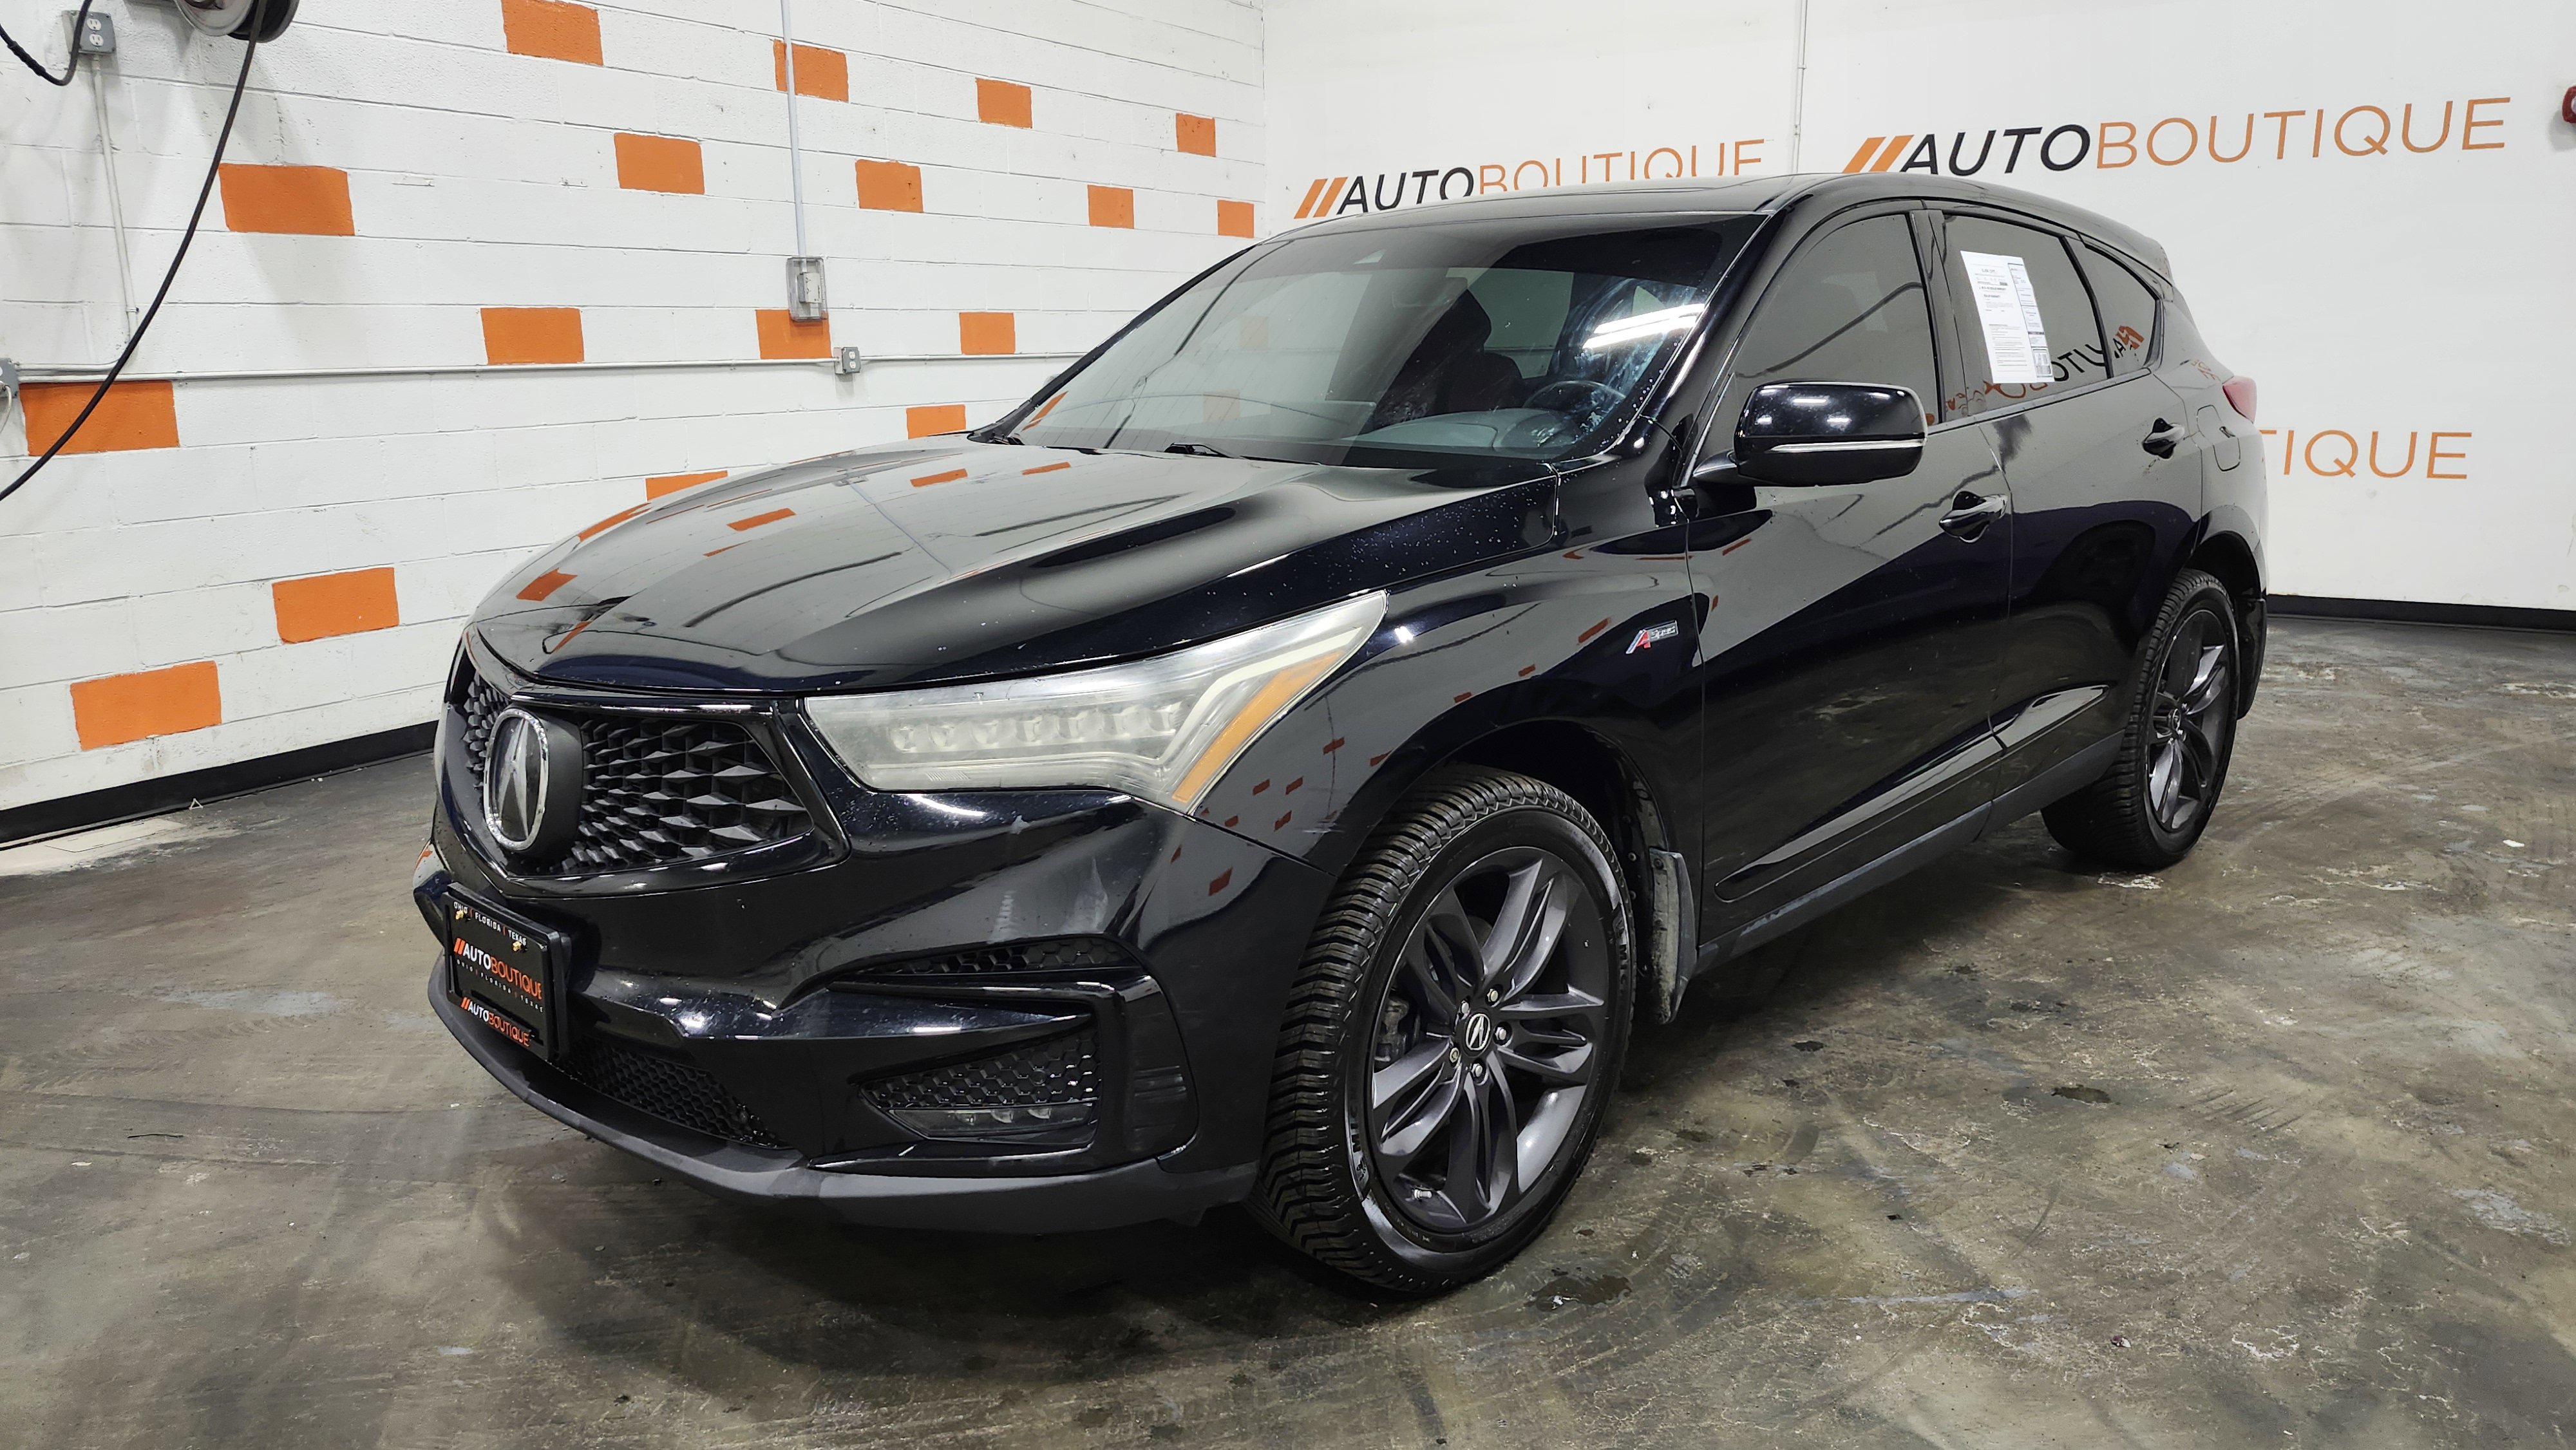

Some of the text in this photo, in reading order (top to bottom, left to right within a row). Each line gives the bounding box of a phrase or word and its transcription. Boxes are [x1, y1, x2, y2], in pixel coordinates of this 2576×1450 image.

[1899, 97, 2510, 174] AUTOBOUTIQUE
[475, 912, 501, 932] FLORIDA
[508, 929, 527, 946] TEXAS
[463, 943, 542, 999] AUTOBOUTIQUE
[468, 1001, 529, 1047] AUTOBOUTIQUE
